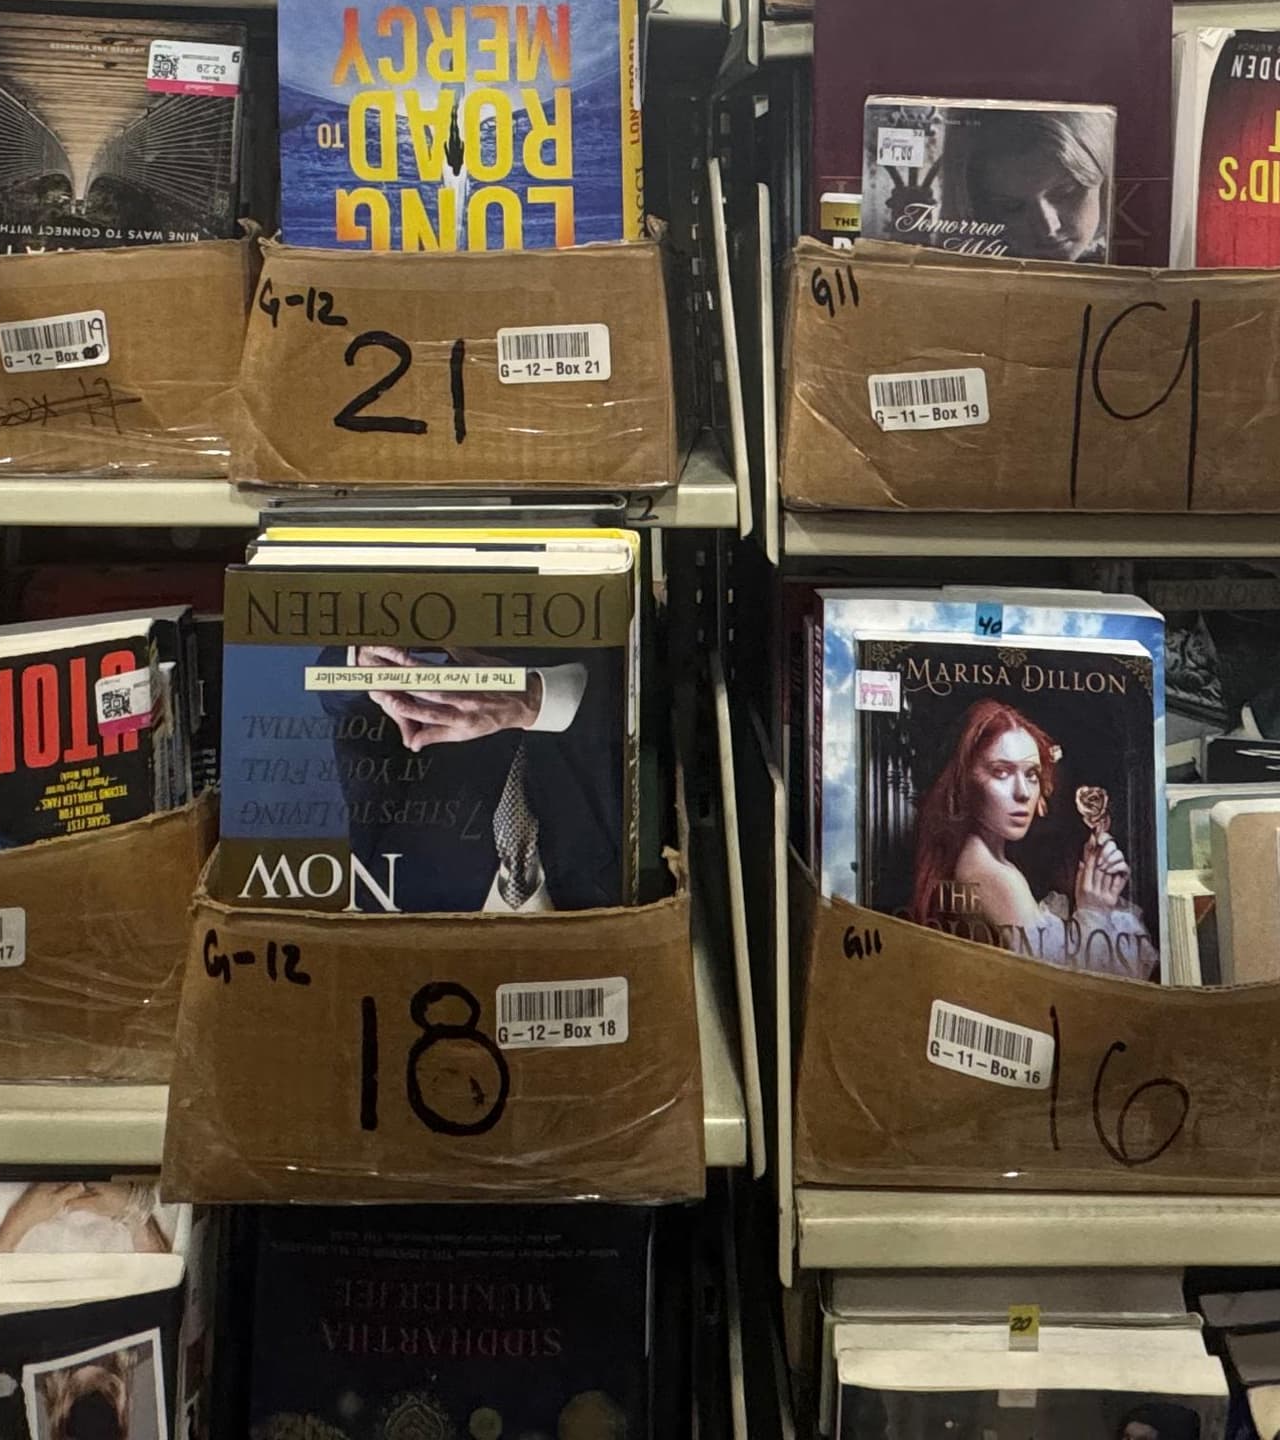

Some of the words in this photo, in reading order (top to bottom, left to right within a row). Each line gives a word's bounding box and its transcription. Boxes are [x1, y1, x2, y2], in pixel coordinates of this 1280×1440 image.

[331, 4, 572, 85] MERCY
[197, 63, 226, 75] $2.29
[317, 123, 345, 149] TO
[348, 87, 574, 182] ROAD
[335, 186, 575, 252] LONG
[833, 217, 858, 227] THE
[895, 203, 1005, 235] Tomorrow
[0, 224, 33, 235] WITH
[38, 225, 101, 239] CONNECT
[105, 229, 122, 240] TO
[128, 231, 164, 242] WAYS
[168, 232, 199, 243] NINE
[584, 361, 601, 376] 21
[334, 330, 466, 444] 21
[964, 403, 980, 418] 19
[1070, 298, 1201, 511] 19
[246, 589, 457, 641] OSTEEN
[483, 586, 605, 641] JOEL
[977, 616, 1002, 635] 40
[314, 670, 373, 684] Bestseller
[377, 670, 412, 685] Times
[416, 671, 441, 685] York
[444, 671, 469, 685] New
[475, 670, 488, 684] #1
[493, 670, 516, 684] The
[902, 658, 1013, 696] MARISA
[1022, 663, 1129, 696] DILLON
[324, 759, 392, 783] YOUR
[239, 799, 330, 825] LIVING
[376, 800, 460, 825] STEPS
[237, 852, 404, 912] NOW
[203, 928, 311, 986] G-12
[598, 1019, 616, 1038] 18
[361, 981, 510, 1136] 18
[1023, 1069, 1041, 1085] 16
[1049, 1005, 1190, 1167] 16
